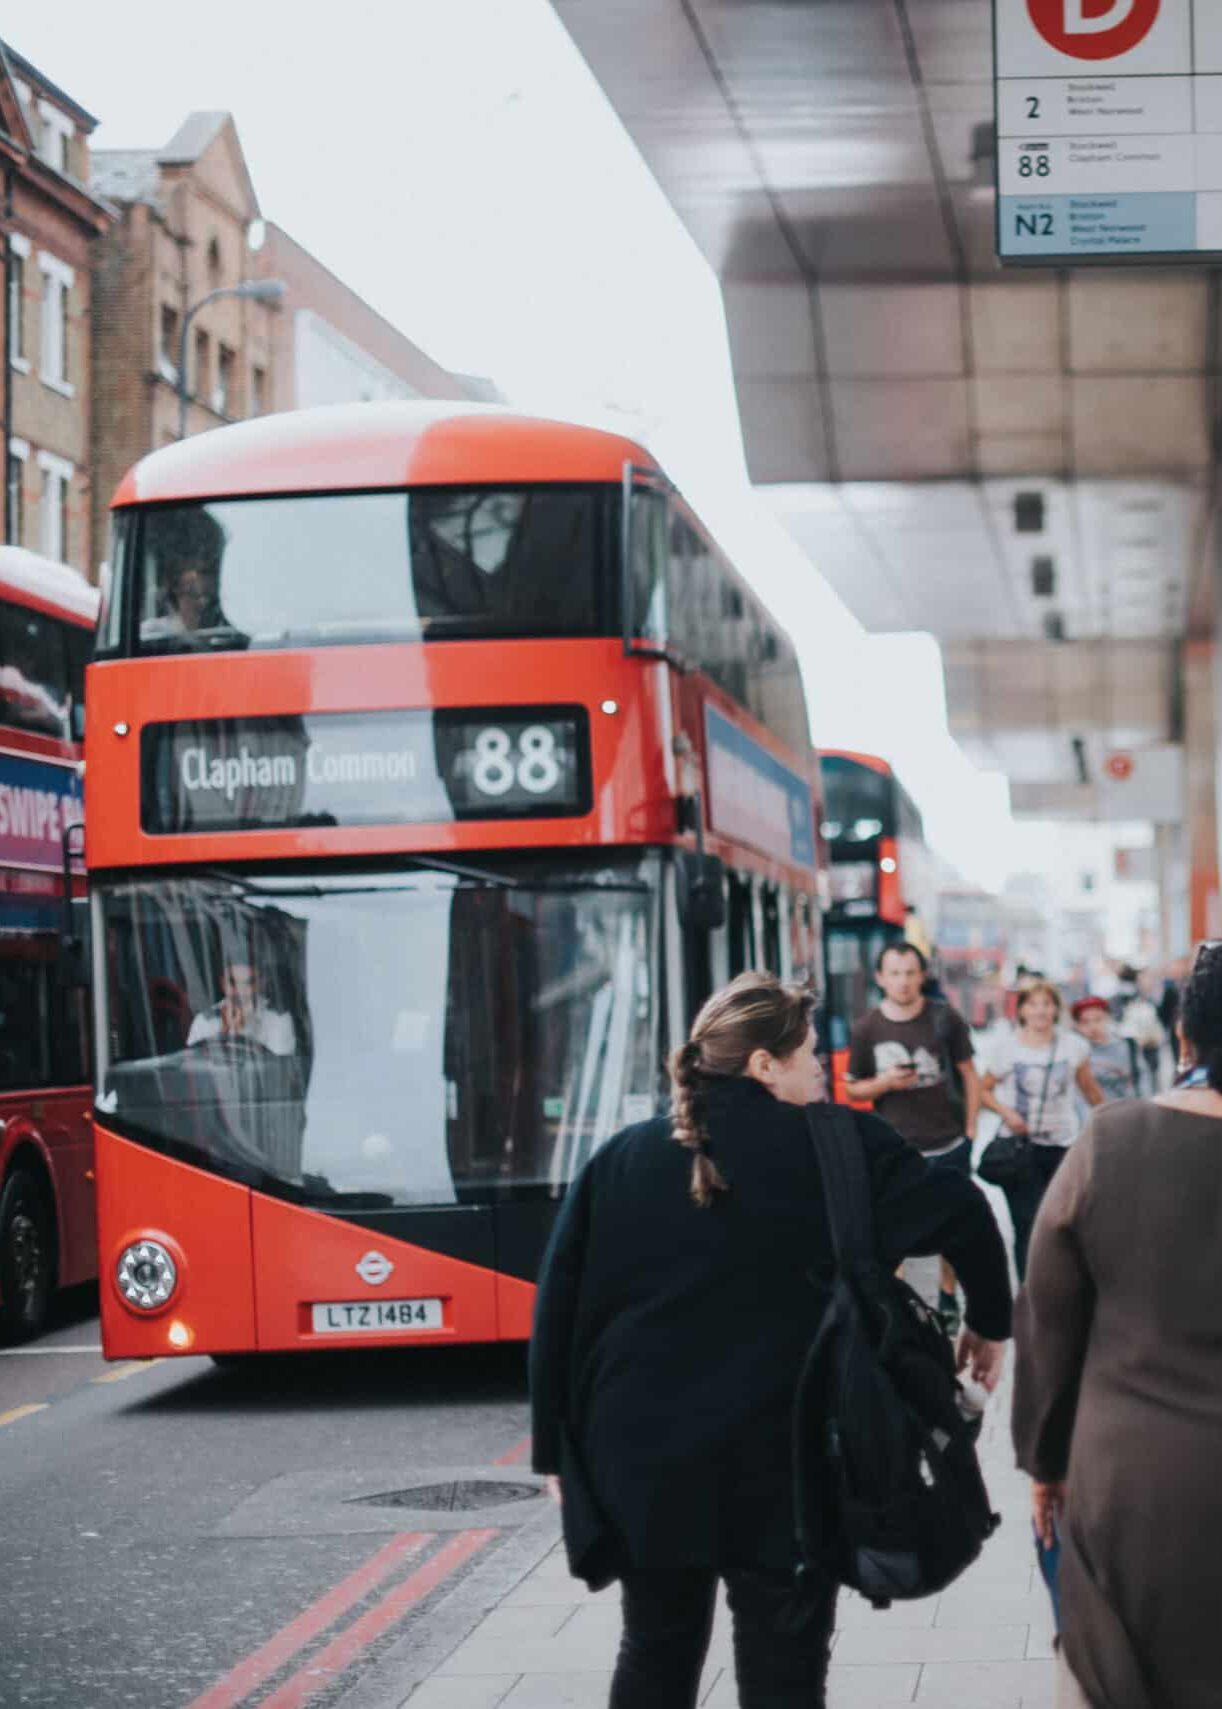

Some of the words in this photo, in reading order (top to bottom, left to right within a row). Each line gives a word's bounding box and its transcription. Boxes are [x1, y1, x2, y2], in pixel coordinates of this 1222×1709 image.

[1026, 96, 1040, 119] 2
[1018, 155, 1051, 177] 88
[1015, 213, 1054, 236] N2
[182, 746, 296, 800] Clapham
[307, 744, 417, 784] Common
[474, 725, 559, 796] 88
